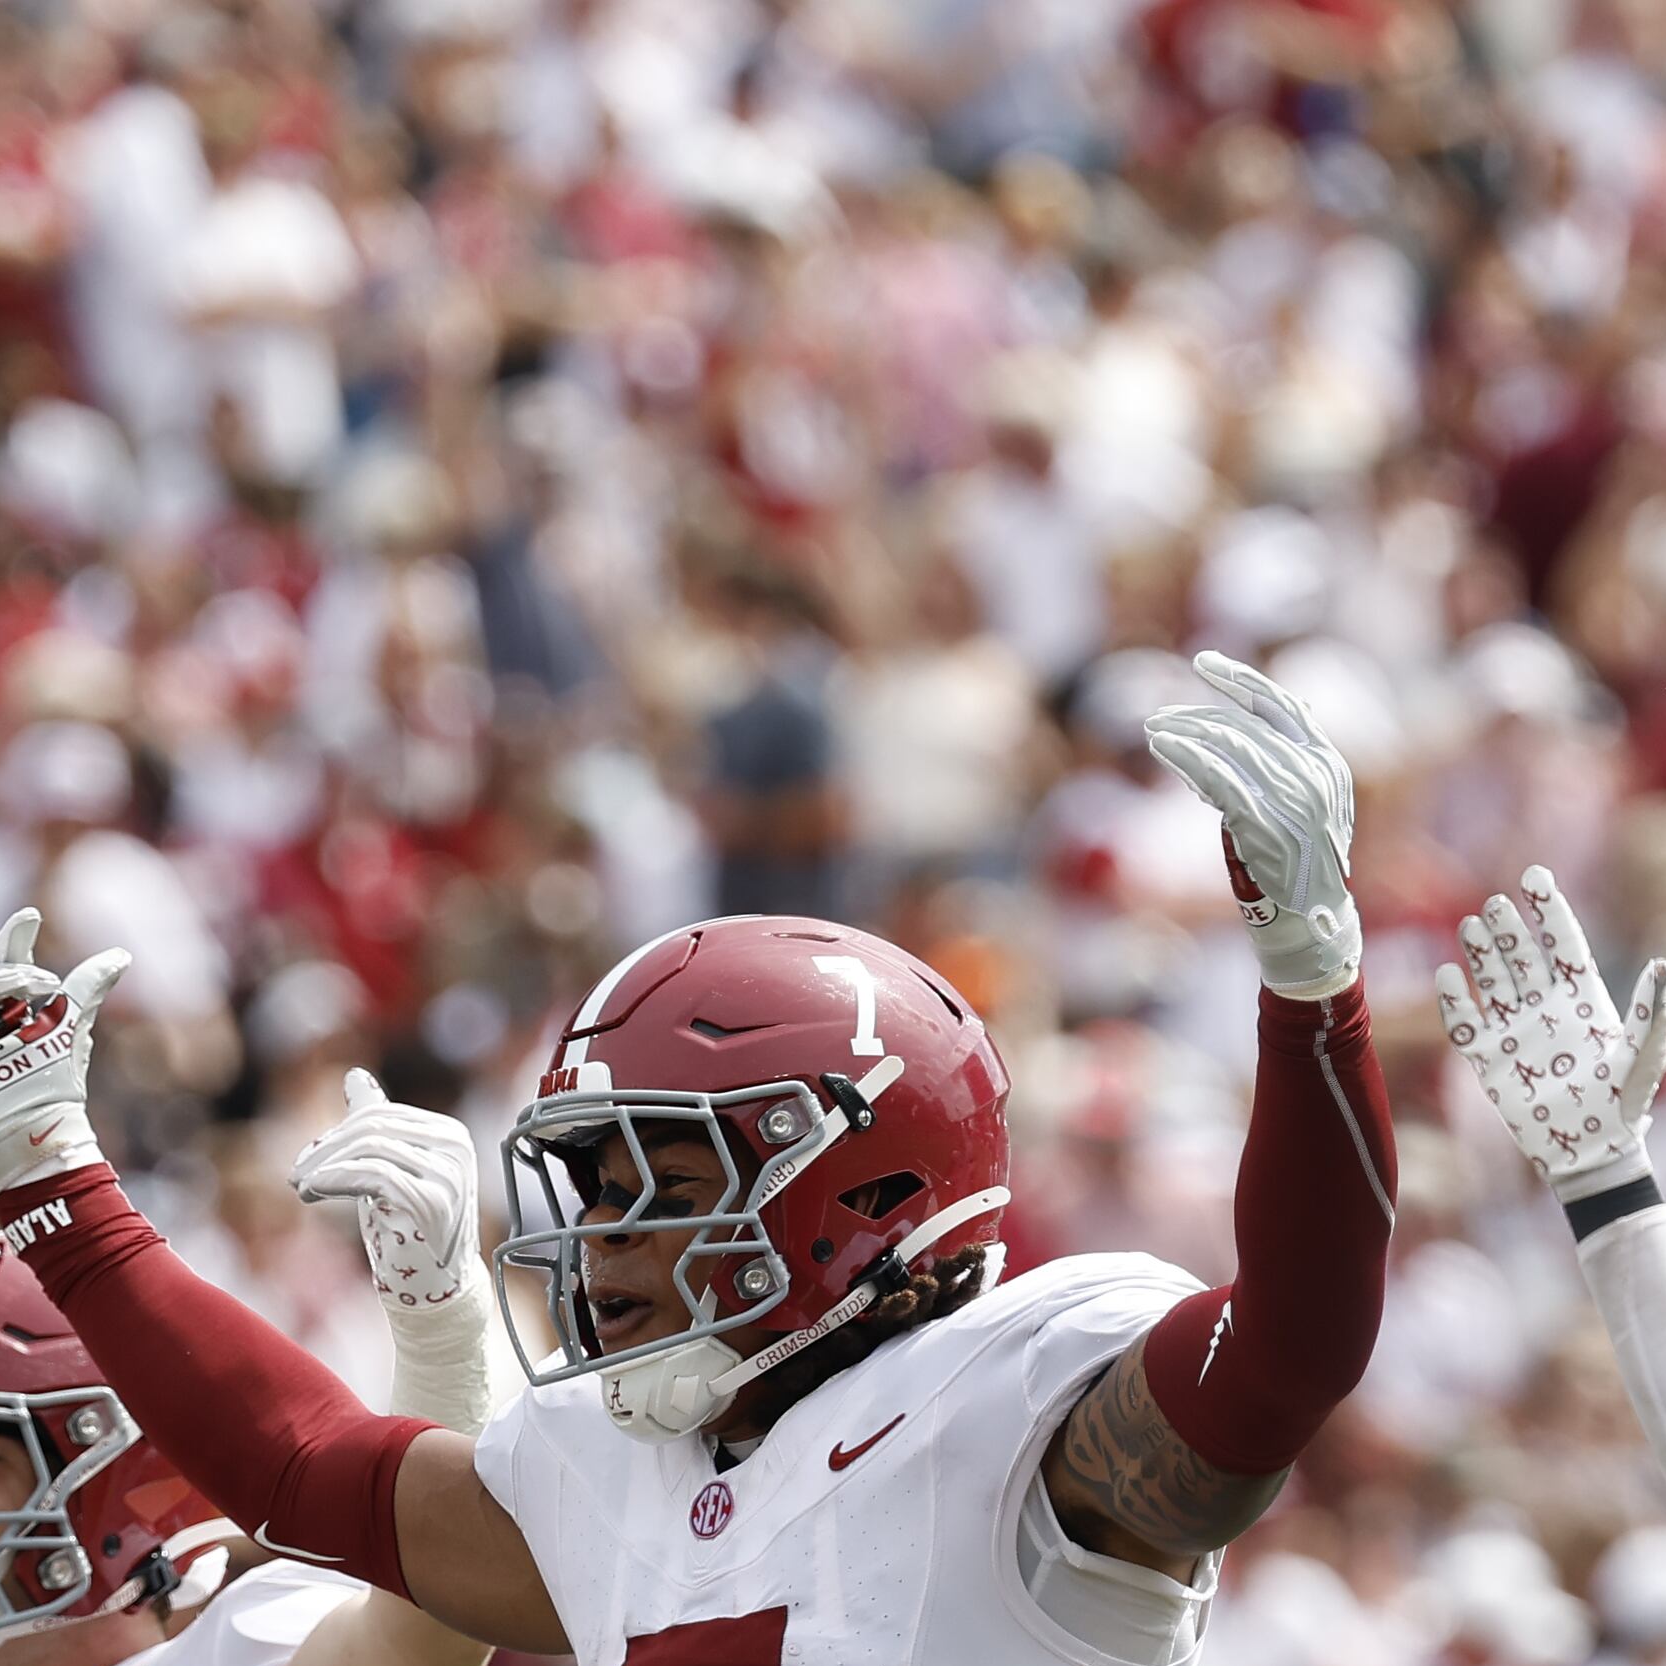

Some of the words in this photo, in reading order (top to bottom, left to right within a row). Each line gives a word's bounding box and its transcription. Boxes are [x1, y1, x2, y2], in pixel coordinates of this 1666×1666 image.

[811, 955, 885, 1056] 7
[755, 1318, 831, 1370] CRIMSON
[832, 1292, 869, 1323] TIDE
[610, 1379, 623, 1409] A
